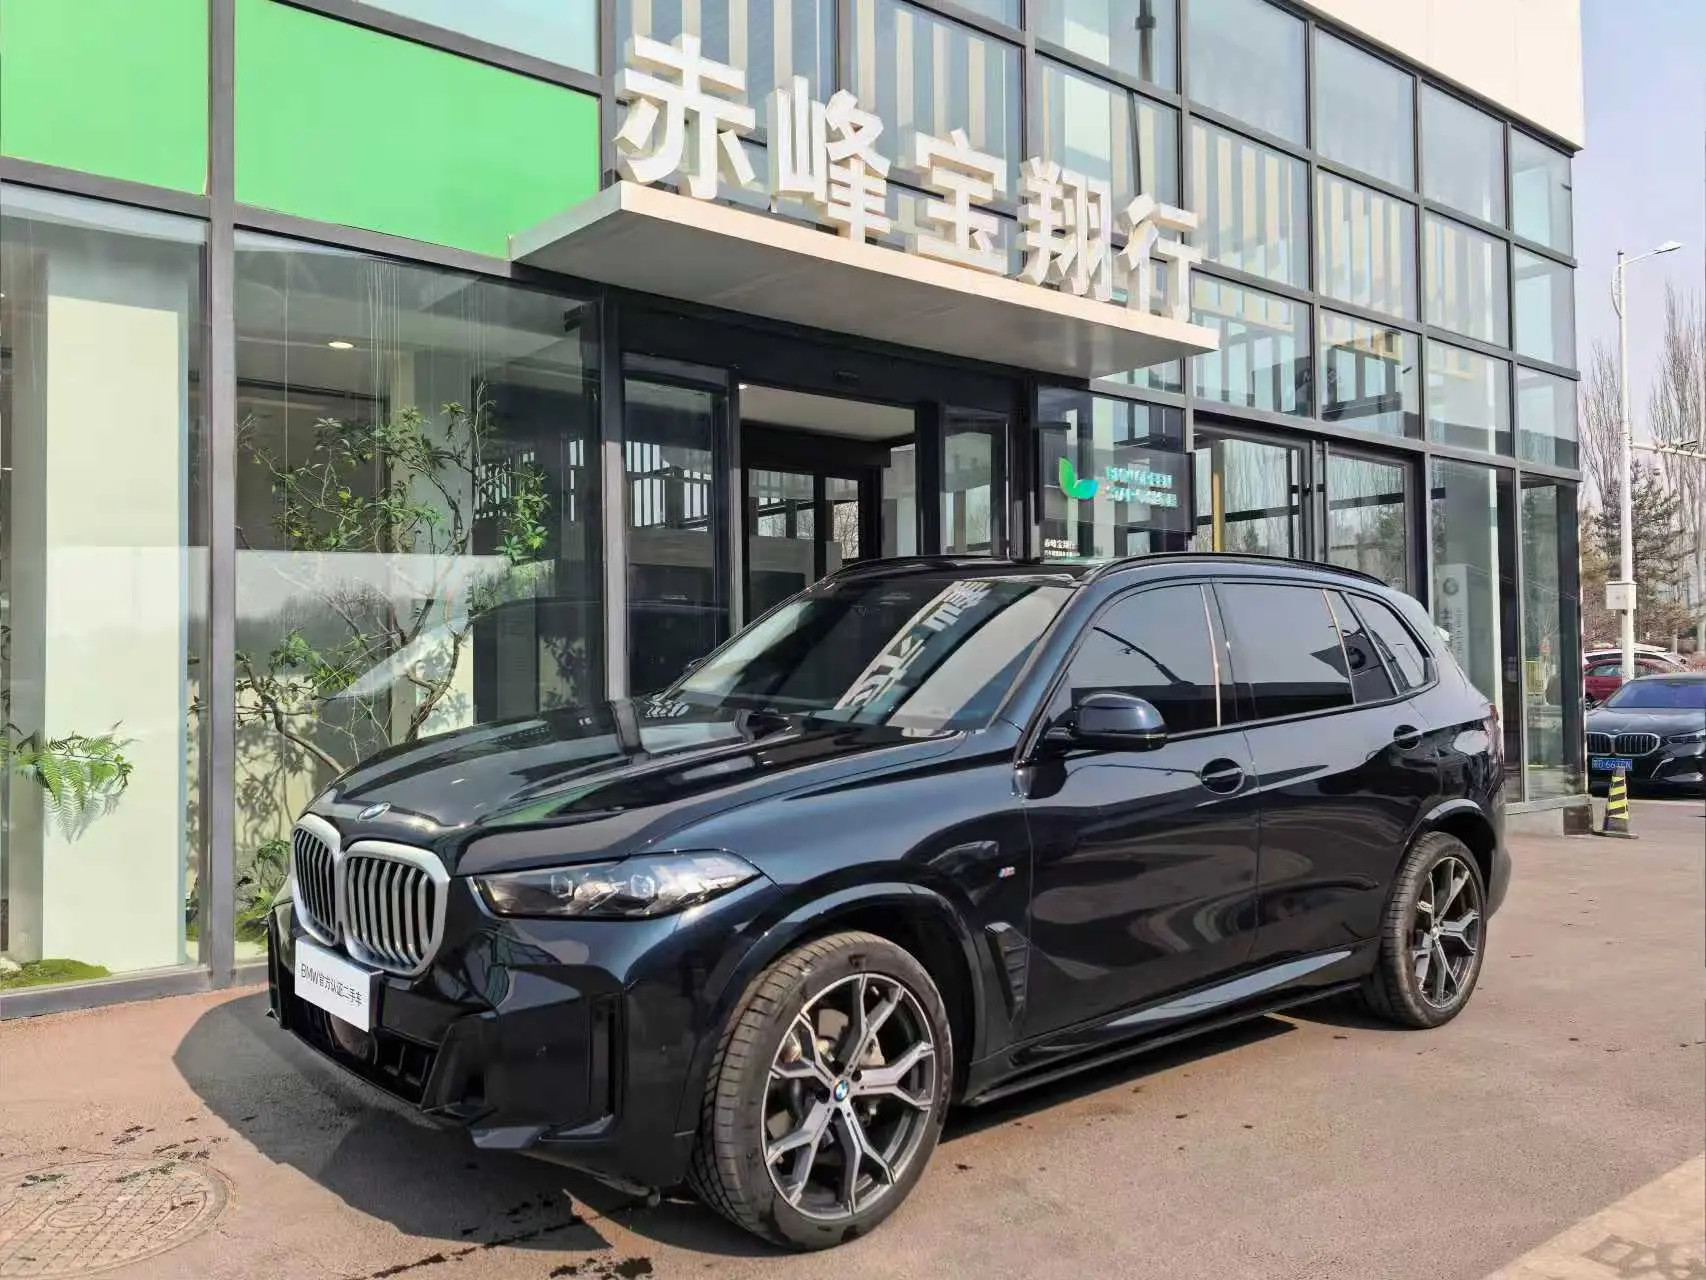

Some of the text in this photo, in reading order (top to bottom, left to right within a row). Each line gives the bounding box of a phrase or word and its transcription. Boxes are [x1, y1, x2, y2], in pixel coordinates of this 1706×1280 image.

[613, 34, 1202, 323] 赤峰宝翔行
